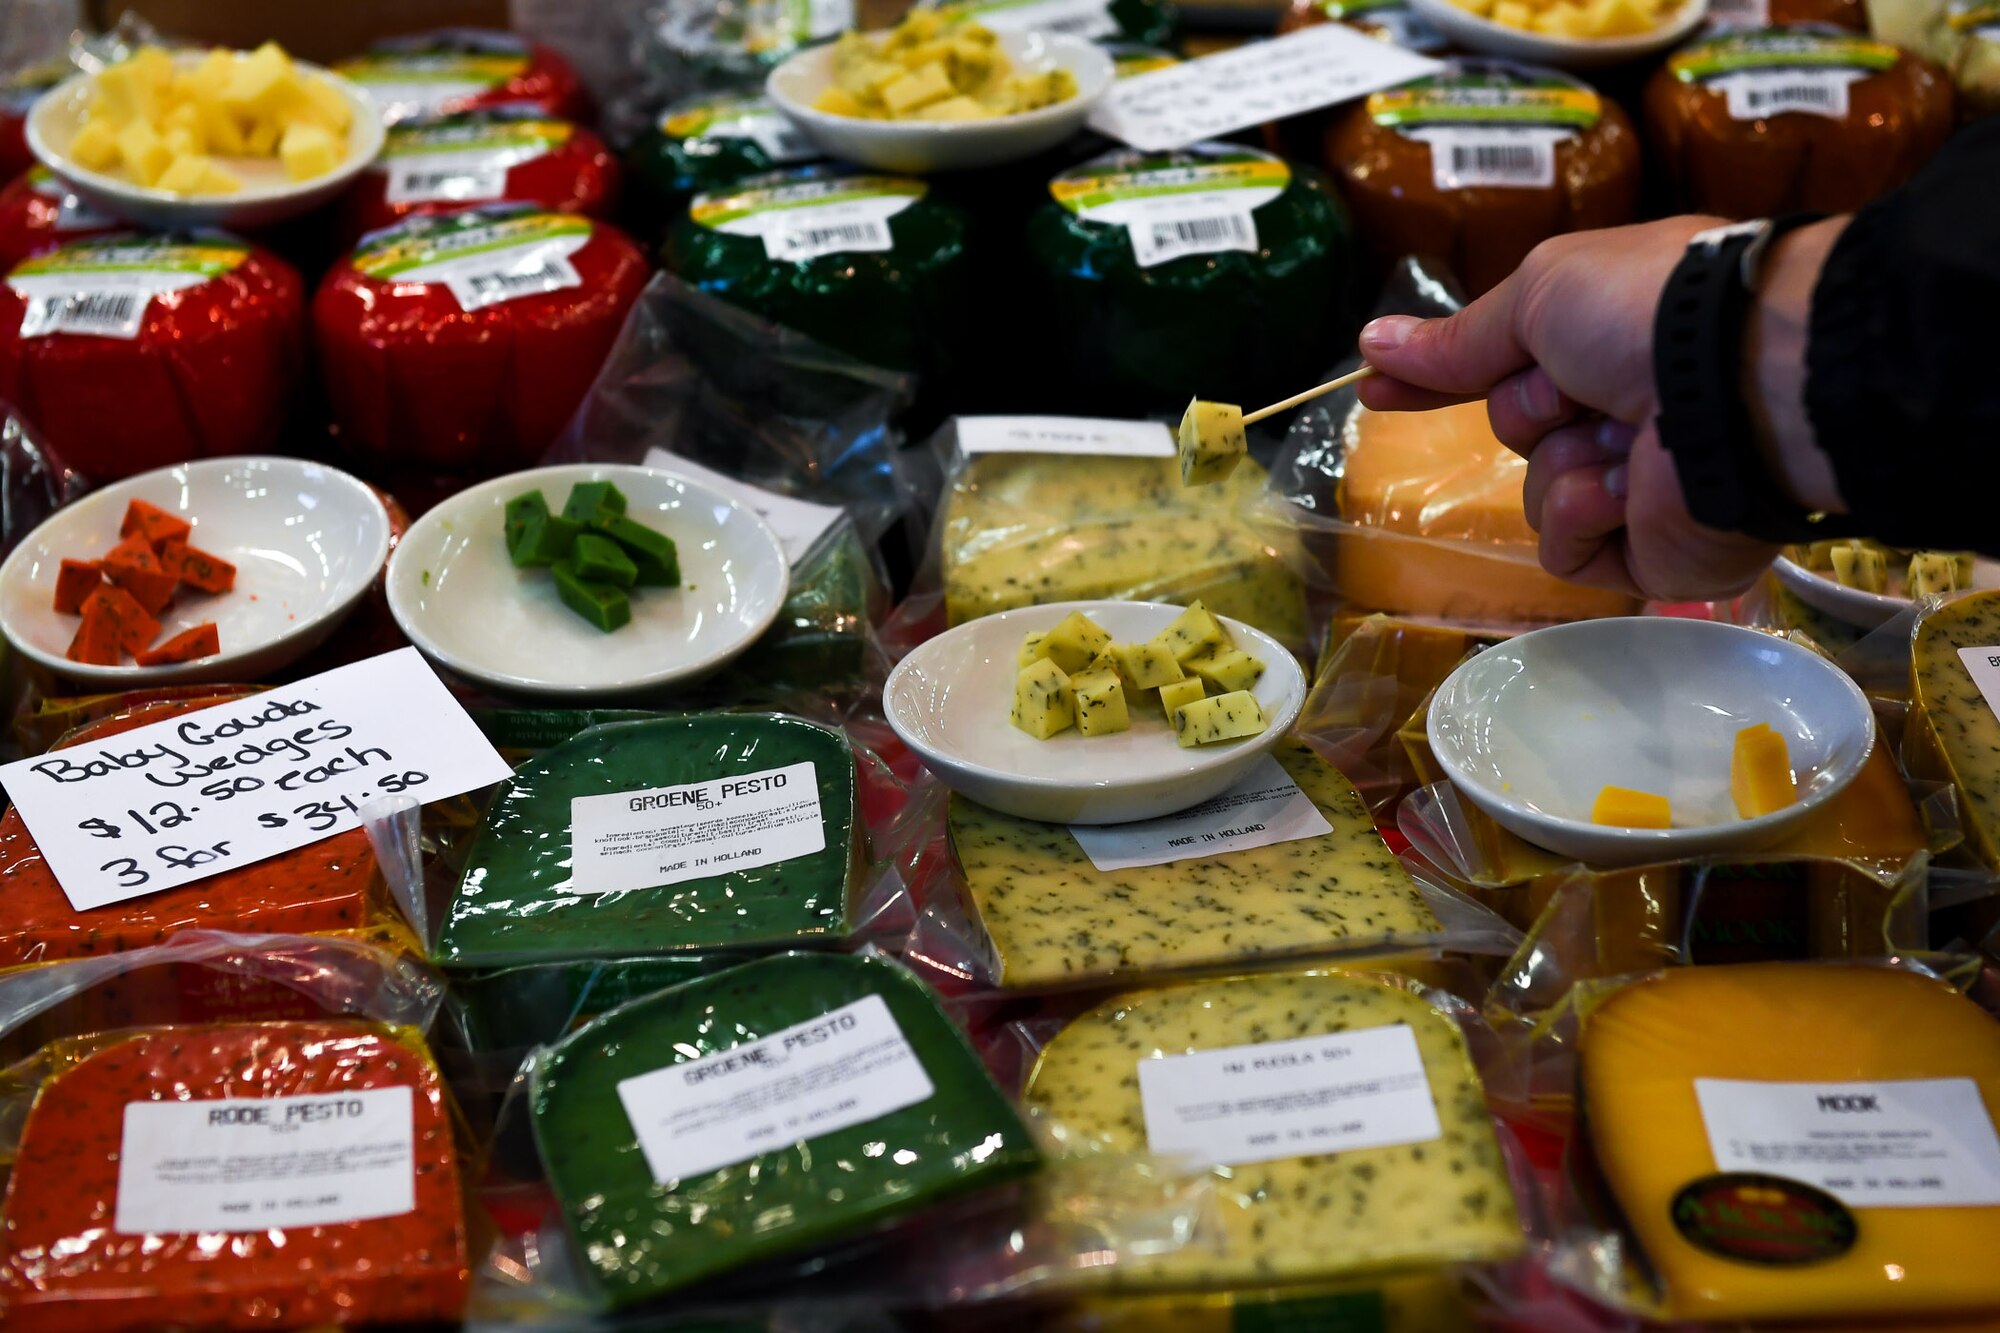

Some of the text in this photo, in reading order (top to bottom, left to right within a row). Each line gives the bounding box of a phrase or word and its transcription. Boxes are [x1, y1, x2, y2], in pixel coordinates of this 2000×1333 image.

[30, 700, 322, 783] Baby Gouda
[274, 747, 393, 791] each
[629, 773, 787, 812] GROENE PESTO
[696, 800, 723, 811] 50+
[1167, 823, 1266, 848] MADE IN HOLLAND
[100, 857, 150, 887] 3
[156, 840, 232, 869] for
[659, 847, 762, 874] MADE IN HOLLAND
[683, 1012, 857, 1087] GROENE PESTO
[208, 1100, 364, 1128] RODE PESTO
[1816, 1094, 1881, 1113] MOOK
